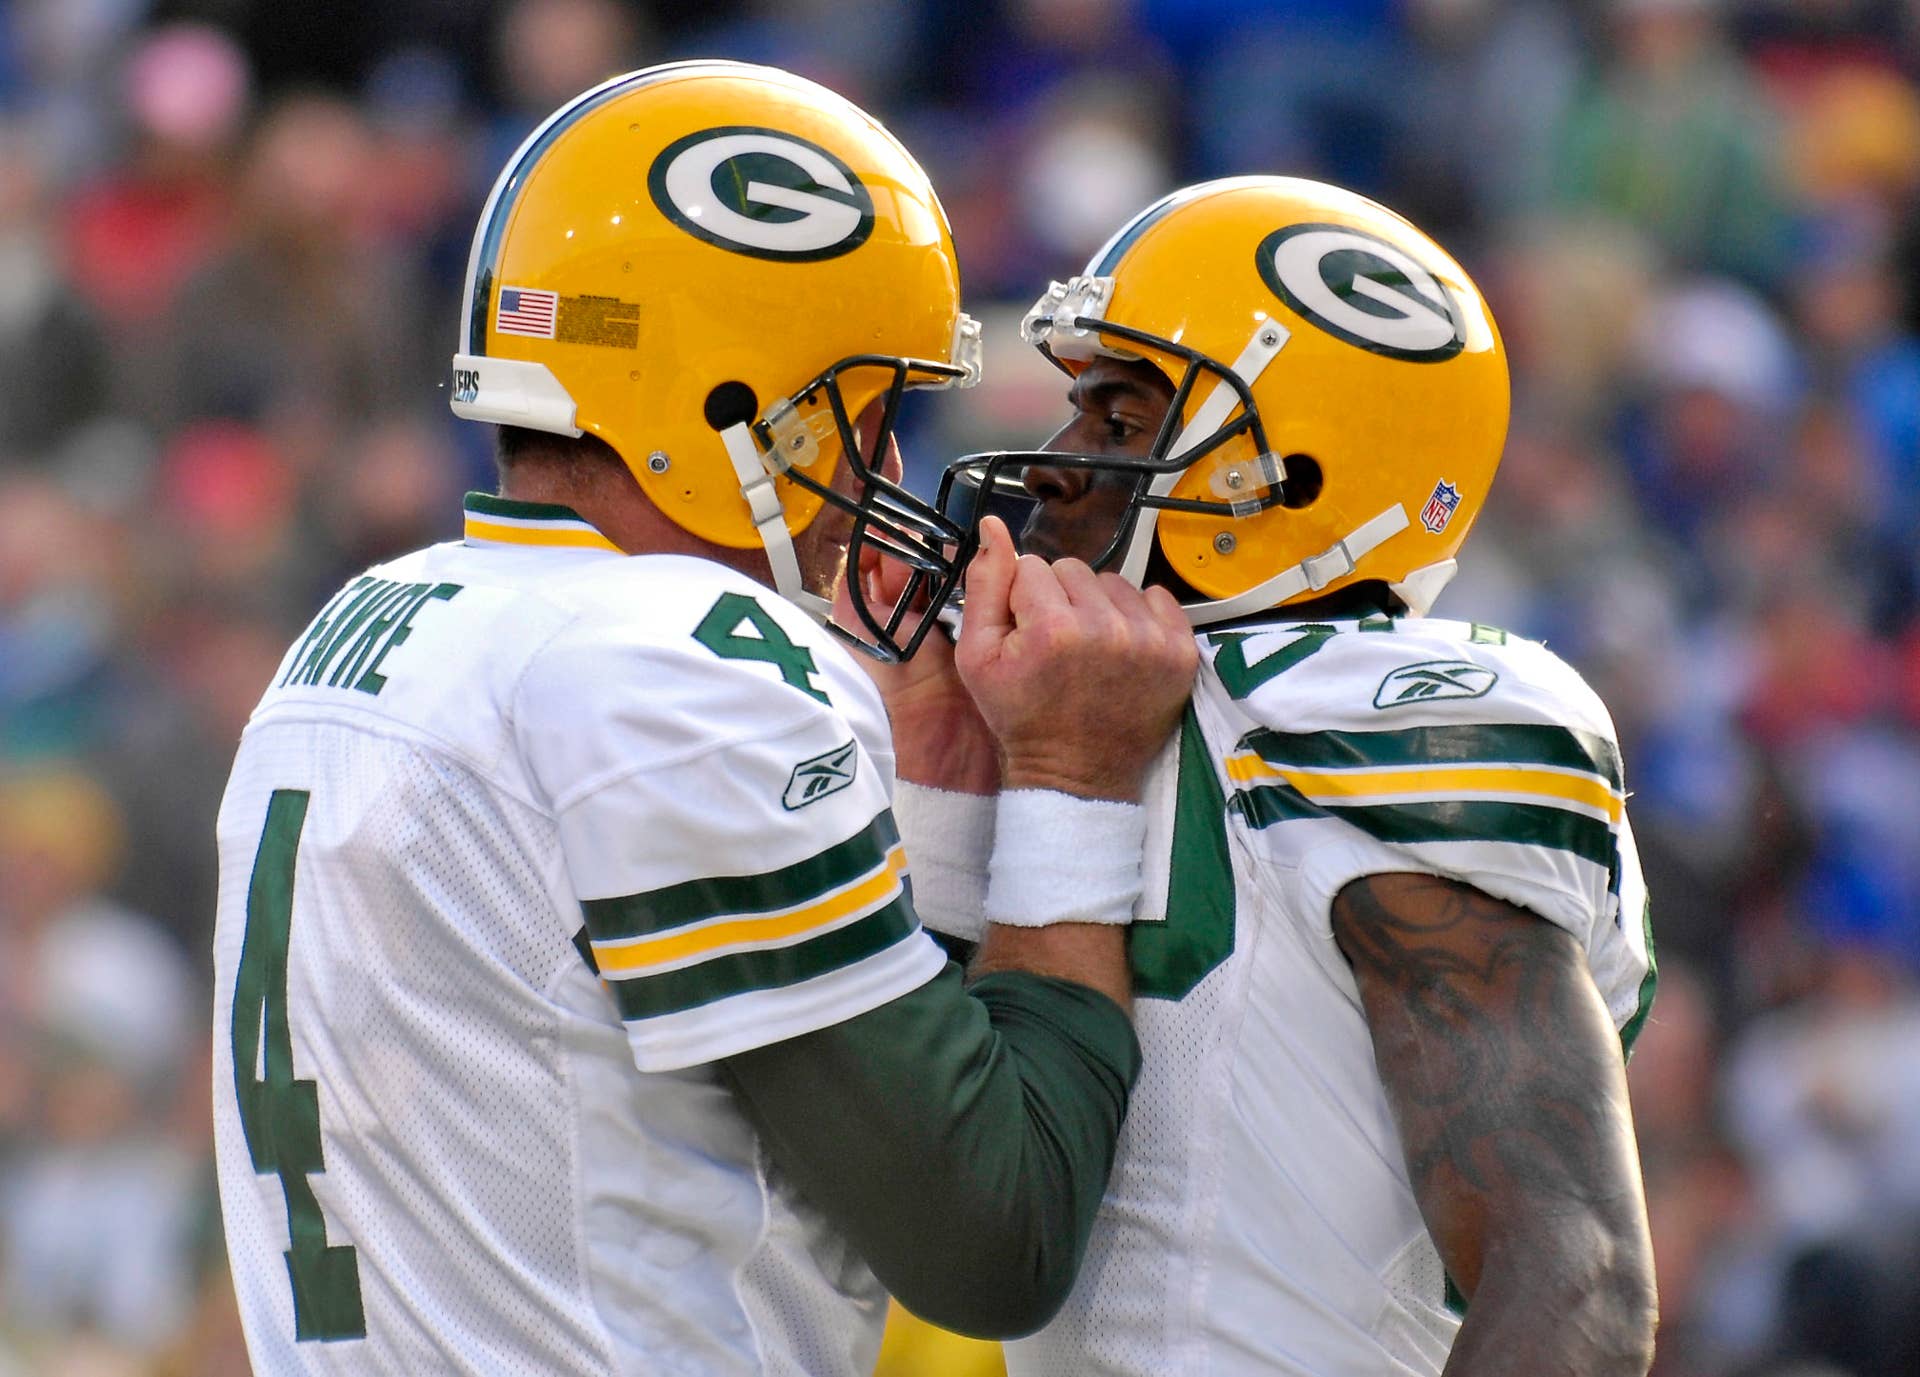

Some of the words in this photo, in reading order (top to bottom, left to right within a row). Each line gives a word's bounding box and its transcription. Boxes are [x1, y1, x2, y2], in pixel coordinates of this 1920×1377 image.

[664, 134, 862, 252] G
[1273, 231, 1456, 351] G
[1424, 498, 1448, 529] NFL
[278, 576, 465, 696] FAVRE
[691, 591, 833, 708] 4
[231, 789, 367, 1342] 4
